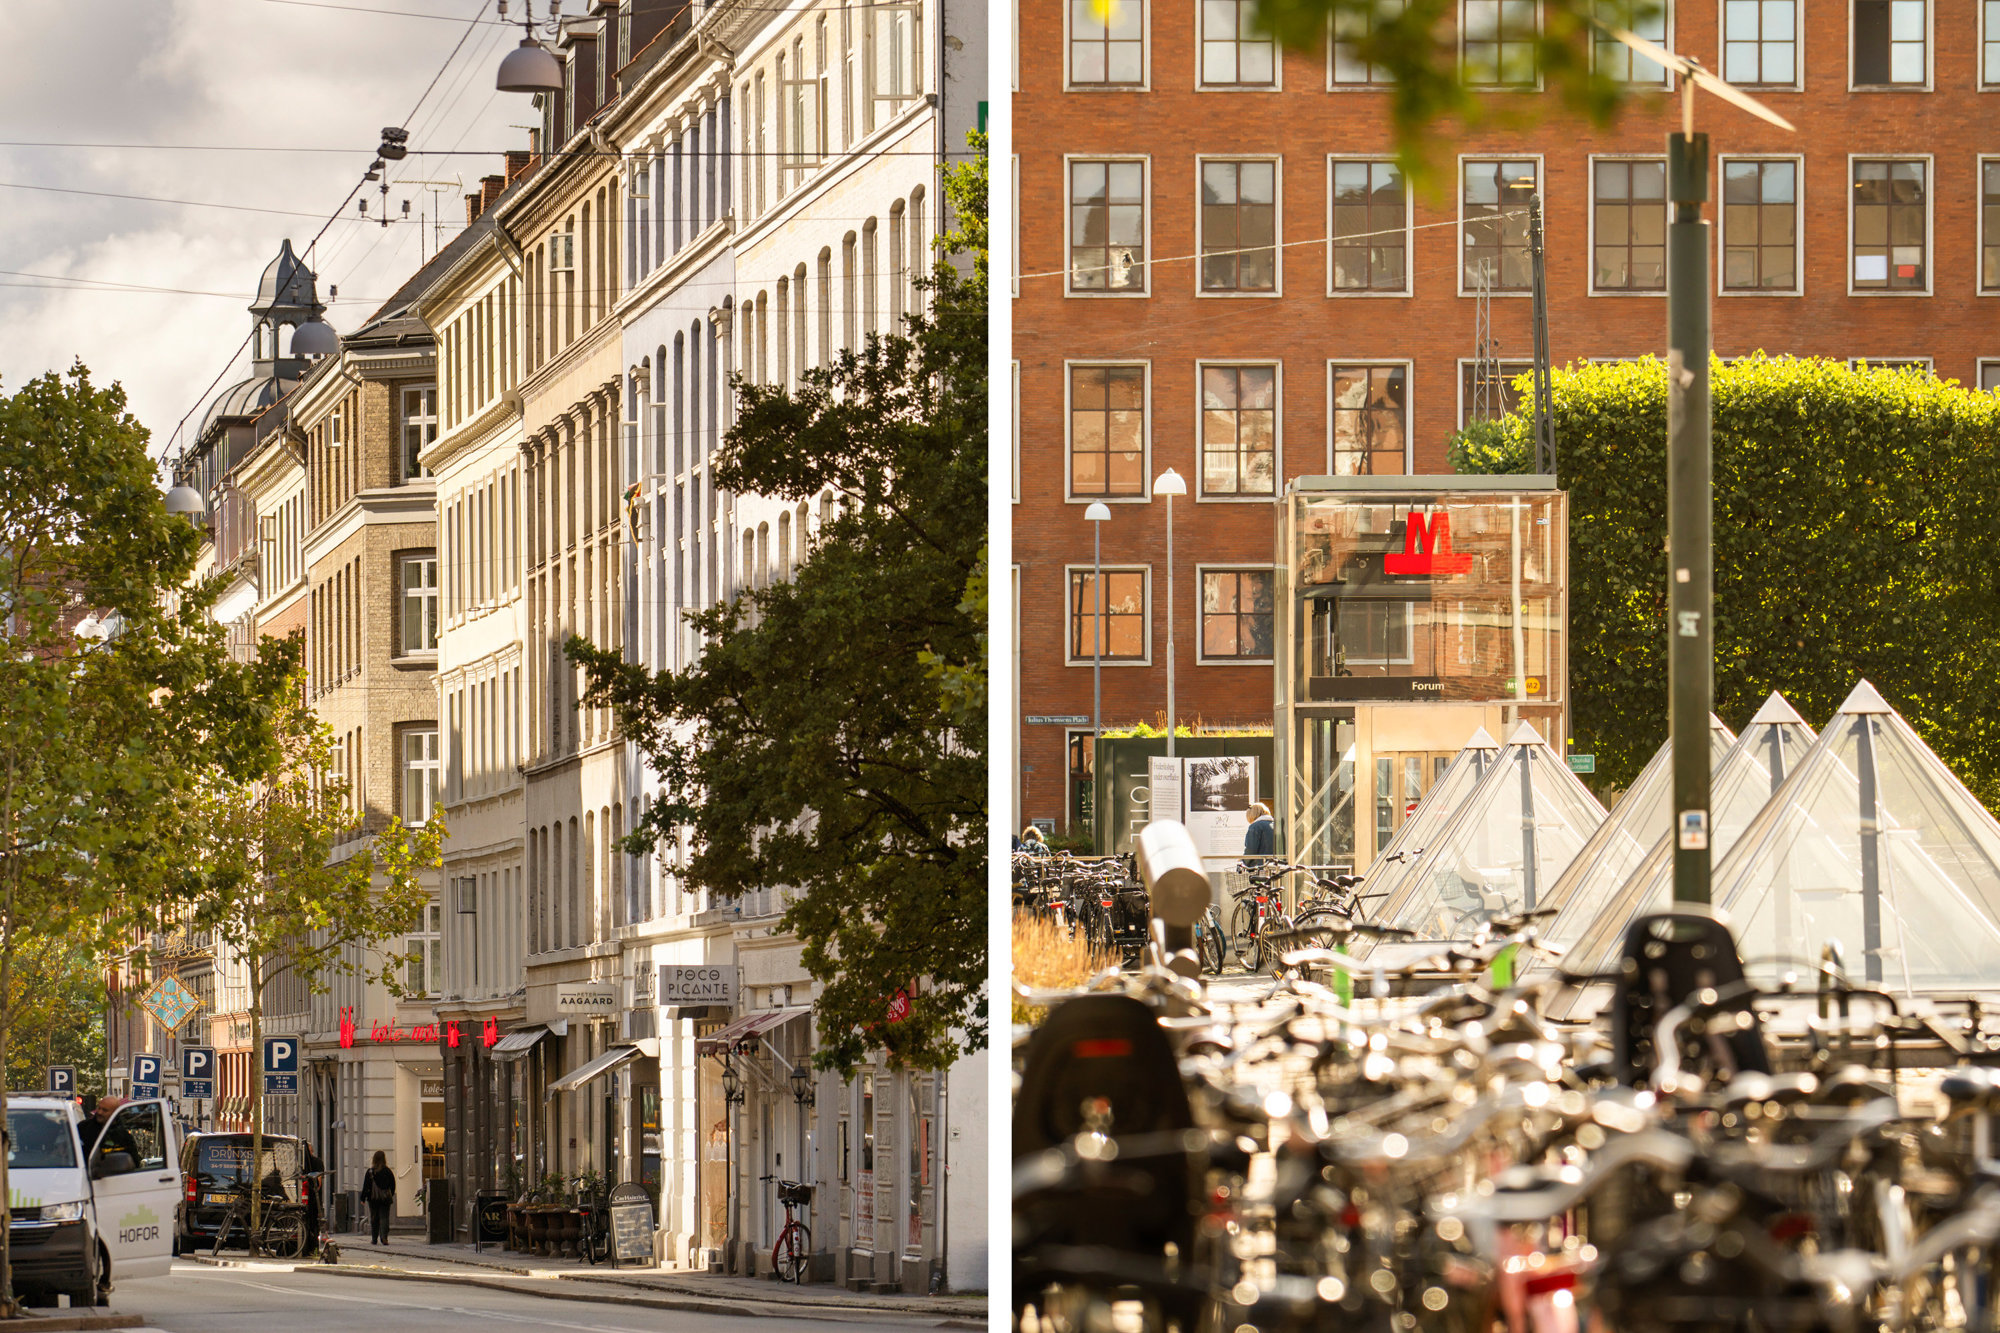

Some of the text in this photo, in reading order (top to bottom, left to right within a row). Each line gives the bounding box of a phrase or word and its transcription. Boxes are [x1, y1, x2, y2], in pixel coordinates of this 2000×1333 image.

[1411, 681, 1445, 691] Forum
[1526, 682, 1538, 690] M2
[676, 969, 720, 981] POCO
[668, 983, 729, 995] PICANTE
[560, 997, 614, 1005] AAGAARD
[272, 1041, 291, 1069] P
[139, 1058, 155, 1081] P
[189, 1051, 207, 1076] P
[55, 1070, 69, 1090] P
[119, 1226, 160, 1243] HOFOR
